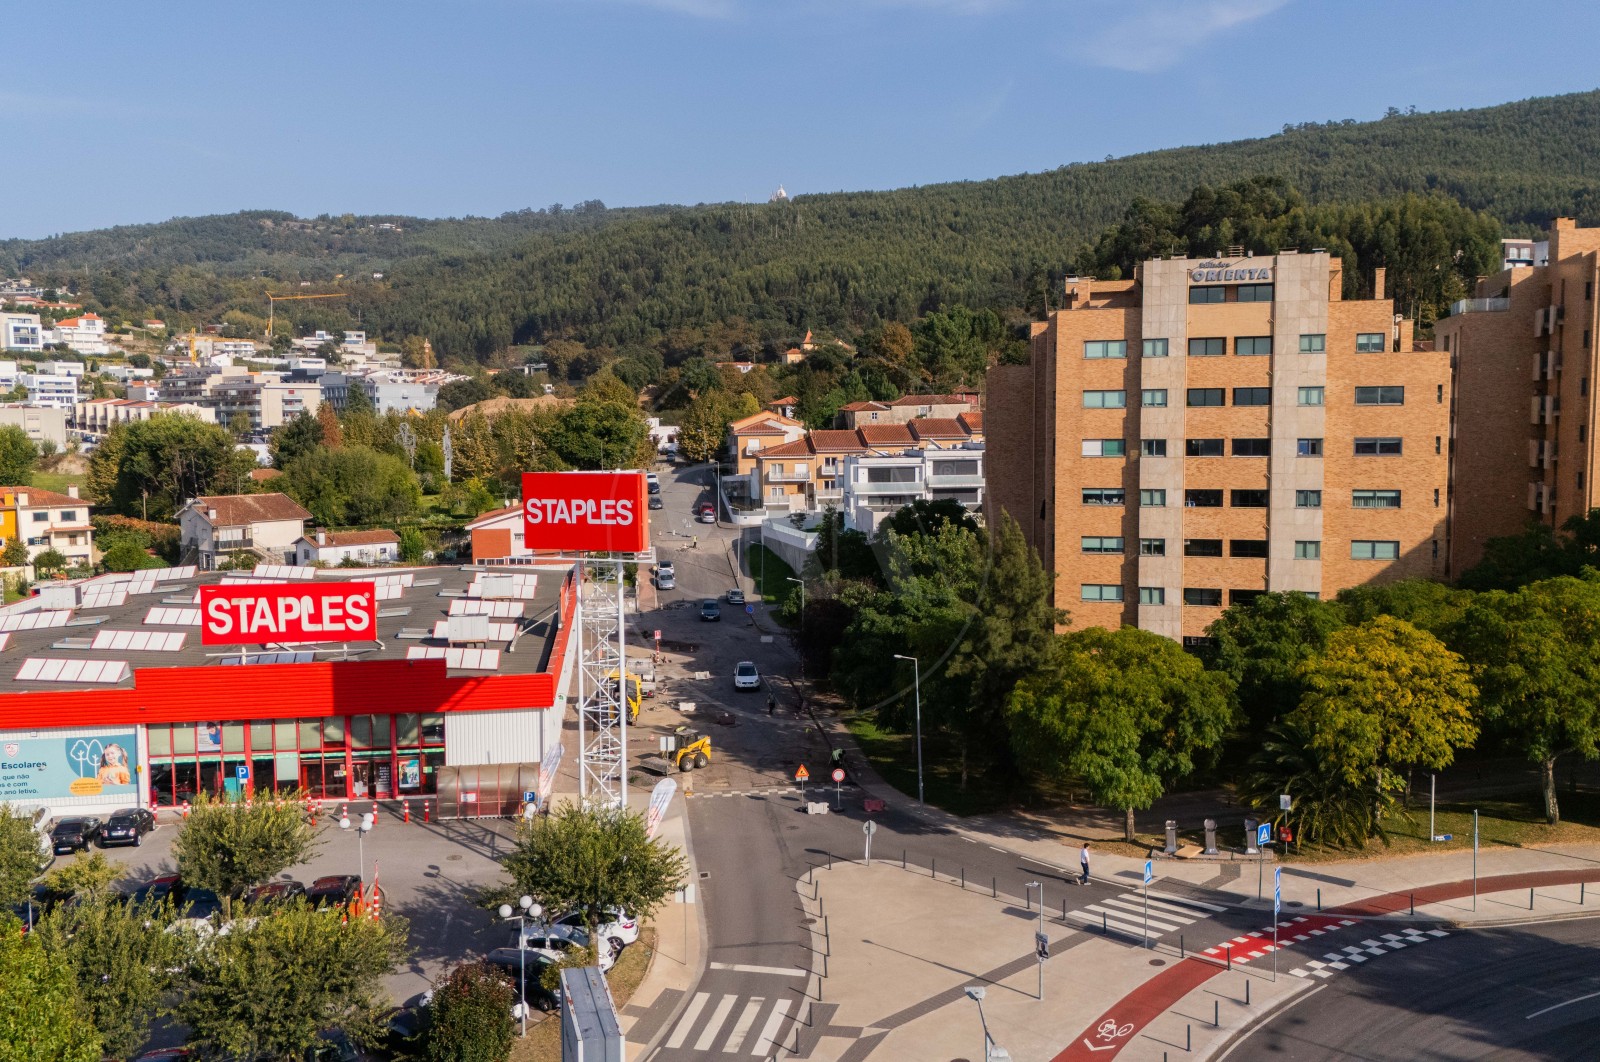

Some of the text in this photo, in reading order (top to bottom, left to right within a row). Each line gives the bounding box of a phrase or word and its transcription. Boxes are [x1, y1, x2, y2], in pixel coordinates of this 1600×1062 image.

[1192, 268, 1269, 282] ORIENTA
[526, 498, 634, 526] STAPLES
[208, 595, 370, 635] STAPLES
[238, 767, 246, 778] P
